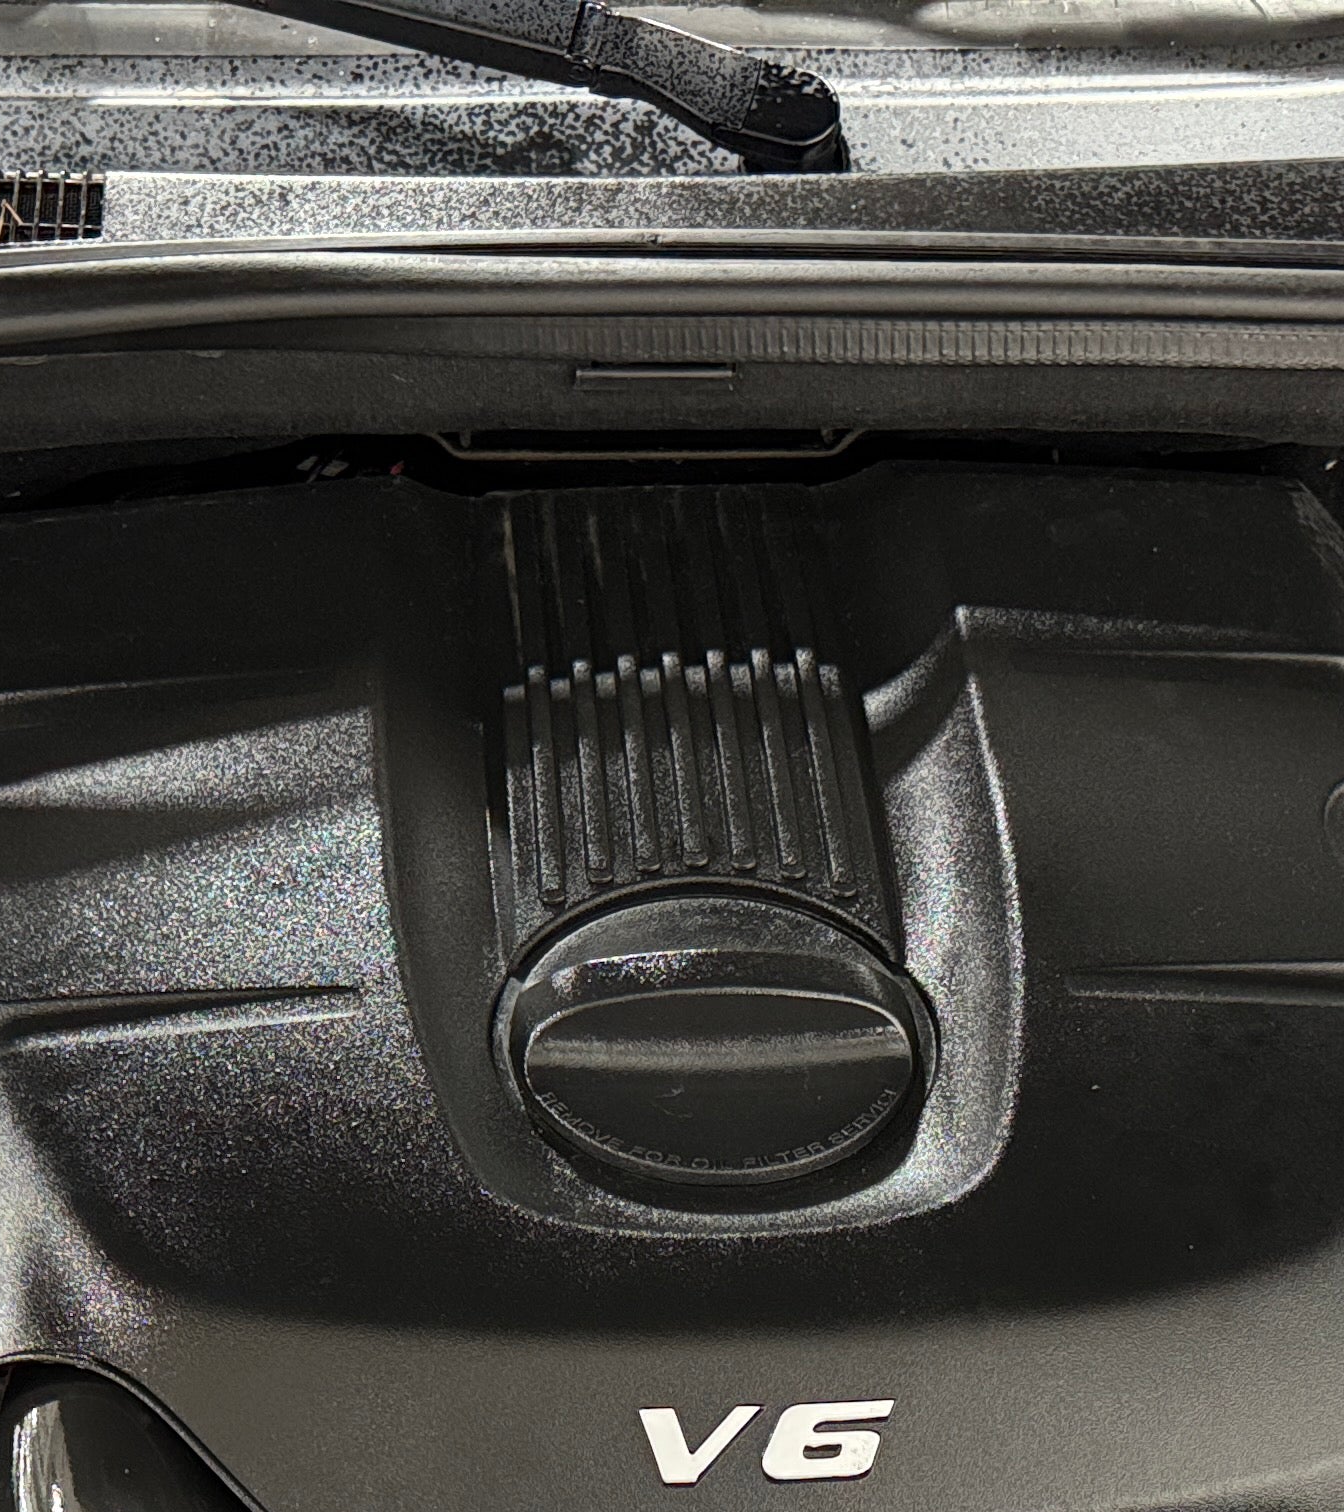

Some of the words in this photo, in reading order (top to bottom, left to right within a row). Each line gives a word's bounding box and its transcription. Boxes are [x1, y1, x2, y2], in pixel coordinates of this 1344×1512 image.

[539, 1091, 625, 1151] REMOVE
[628, 1144, 682, 1167] FOR
[690, 1156, 733, 1171] OIL
[742, 1141, 826, 1169] FILTER
[638, 1398, 896, 1485] V6
